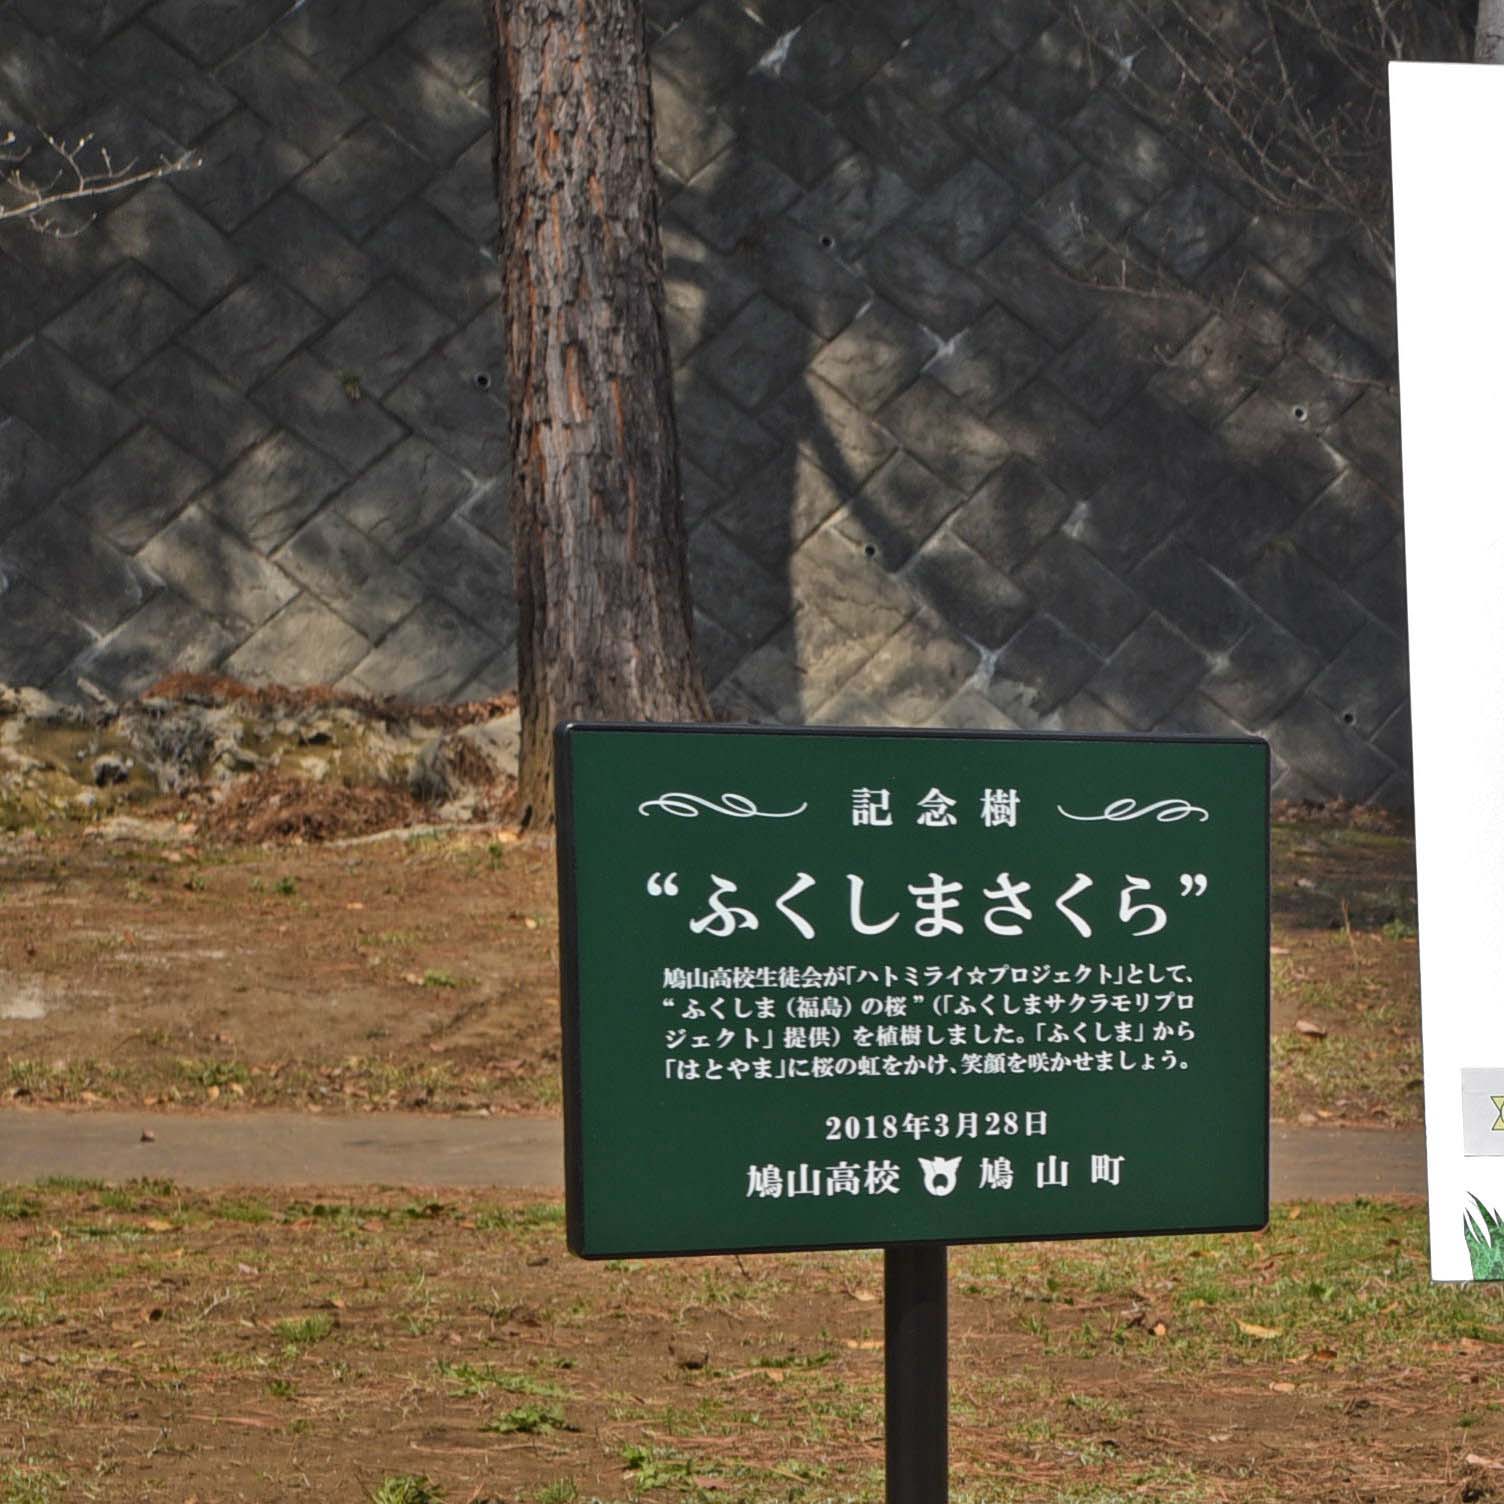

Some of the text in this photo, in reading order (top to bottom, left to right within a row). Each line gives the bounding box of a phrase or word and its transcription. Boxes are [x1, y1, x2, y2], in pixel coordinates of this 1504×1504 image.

[852, 788, 1021, 828] 記念樹
[825, 1110, 1048, 1141] 2018年3月28日
[746, 1159, 901, 1199] 鳩山高校
